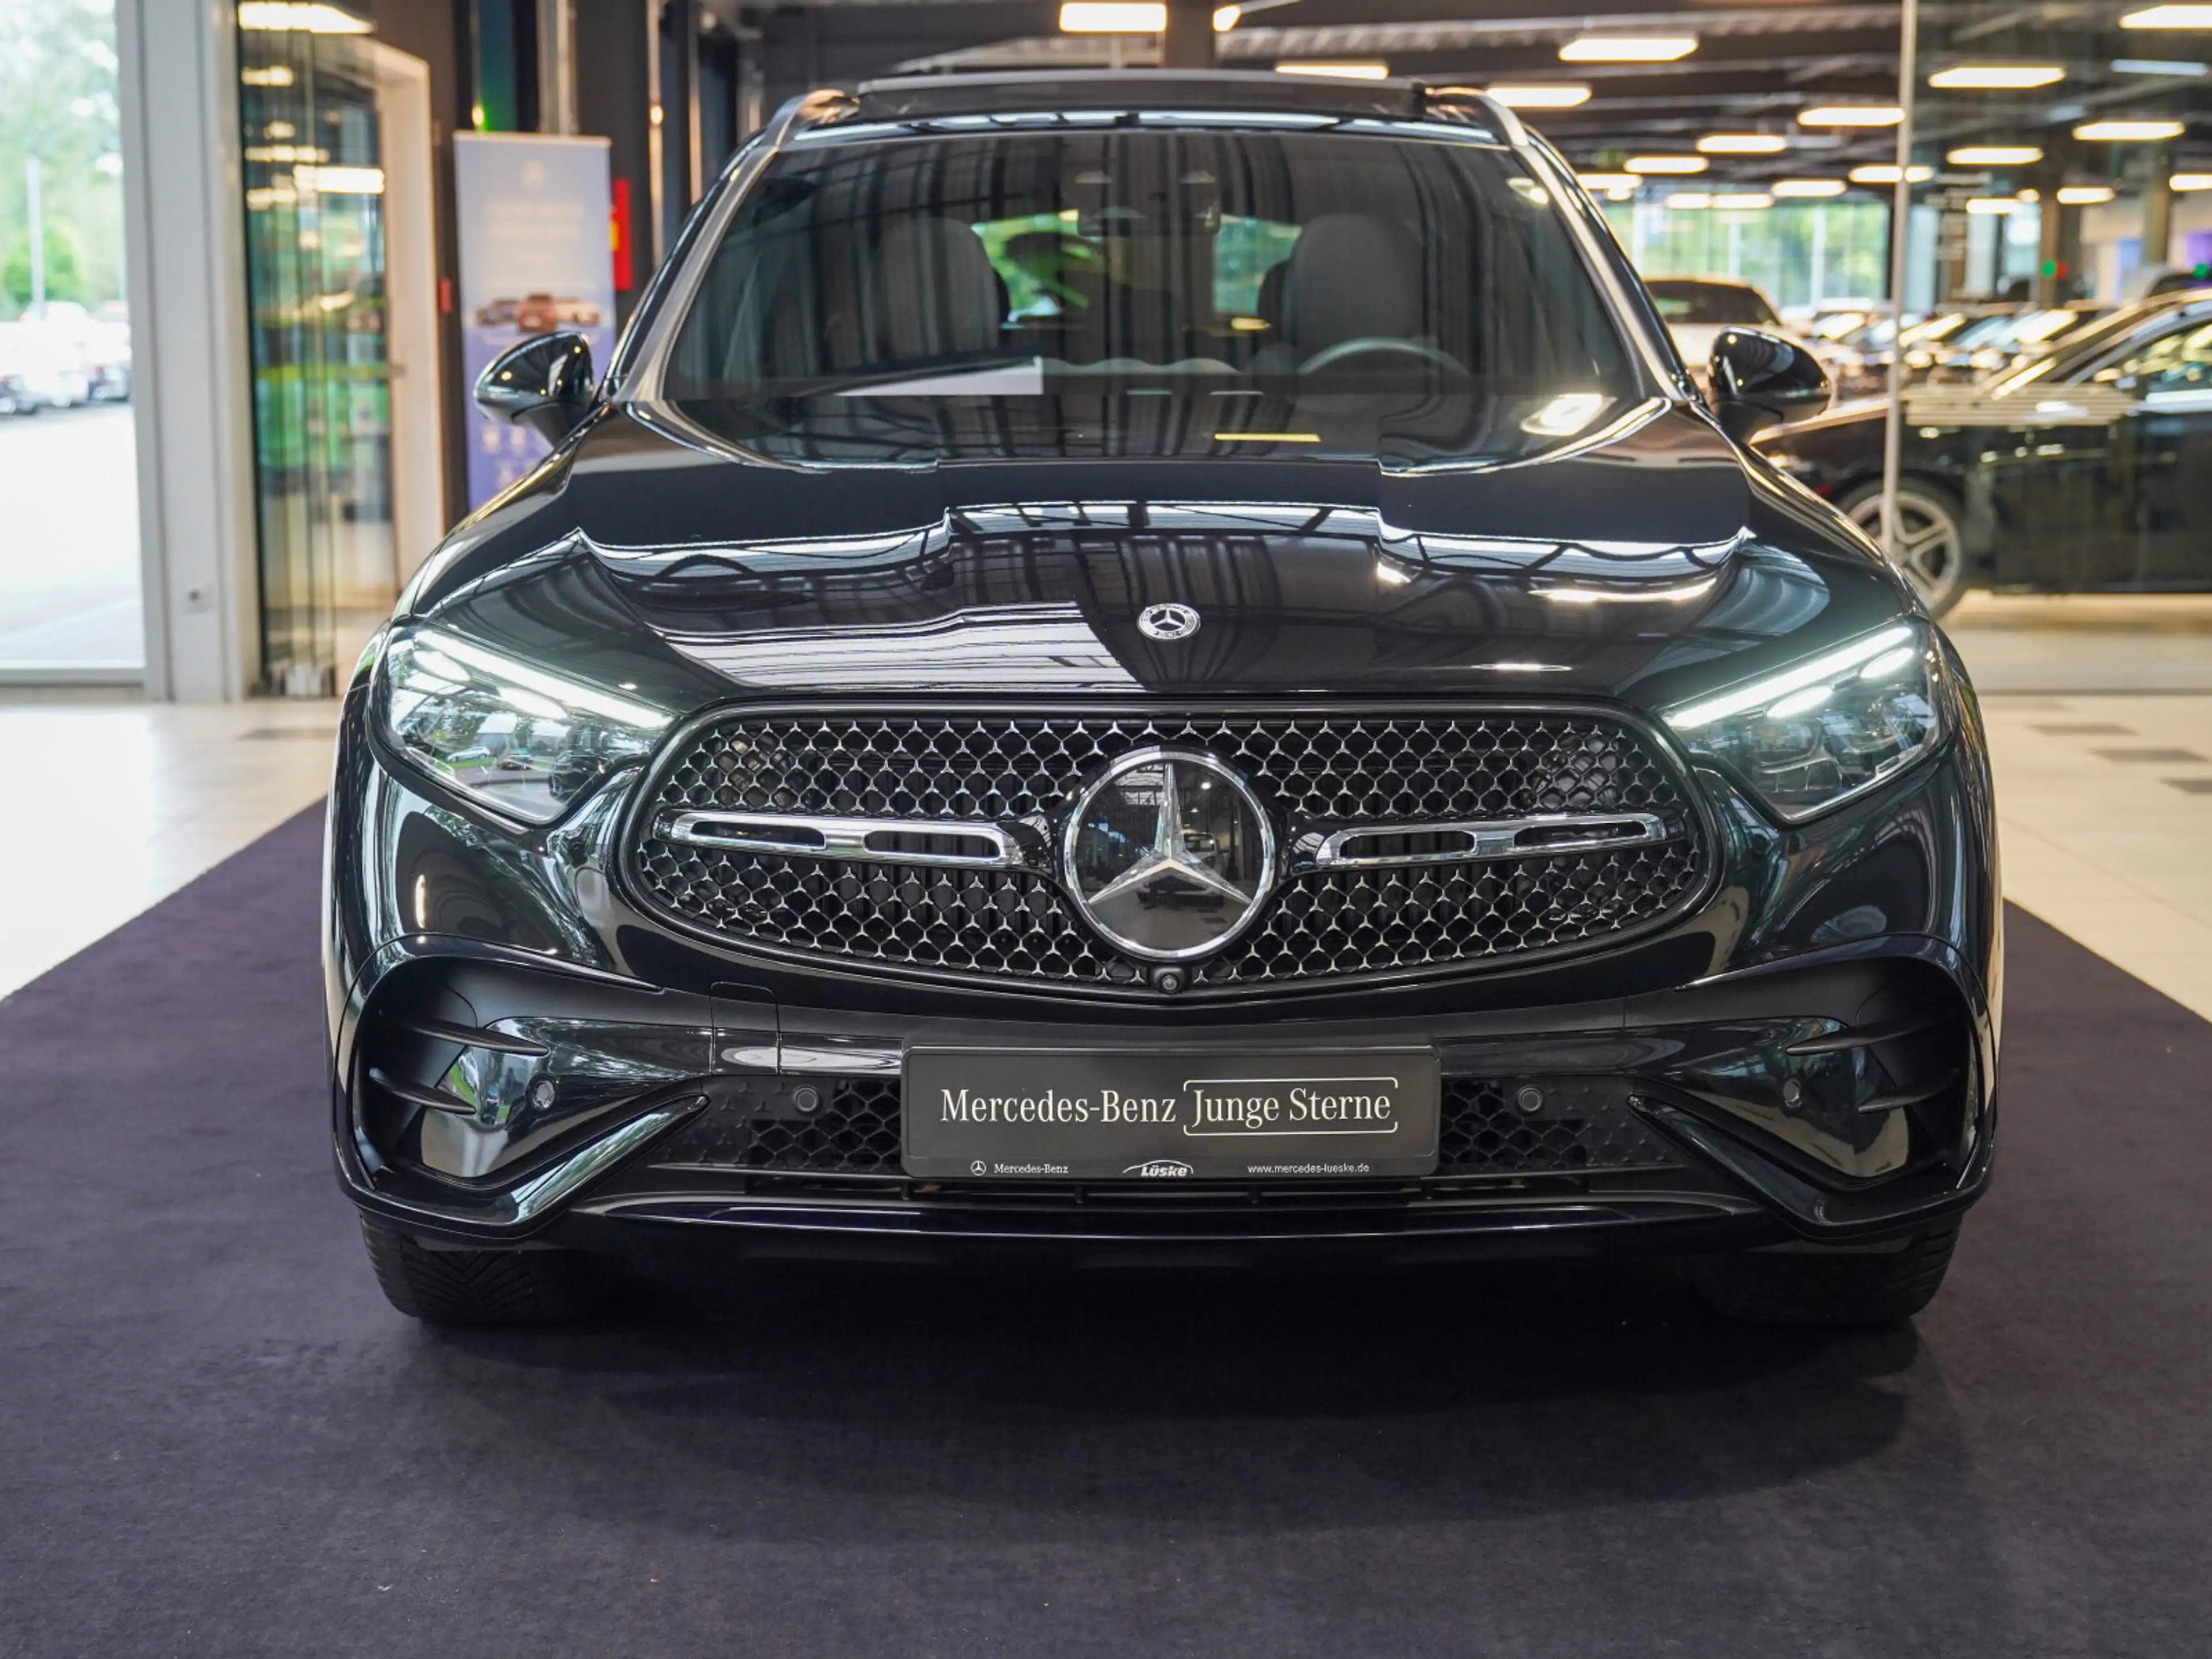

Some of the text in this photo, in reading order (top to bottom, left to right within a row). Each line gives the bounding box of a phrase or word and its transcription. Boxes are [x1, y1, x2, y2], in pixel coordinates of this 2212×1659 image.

[940, 1087, 1391, 1129] Mercedes-Benz Junge Sterne
[993, 1162, 1069, 1174] Mercedes-Benz
[1140, 1164, 1188, 1178] Lüske
[1247, 1162, 1370, 1174] www.mercedes-lueske.de
